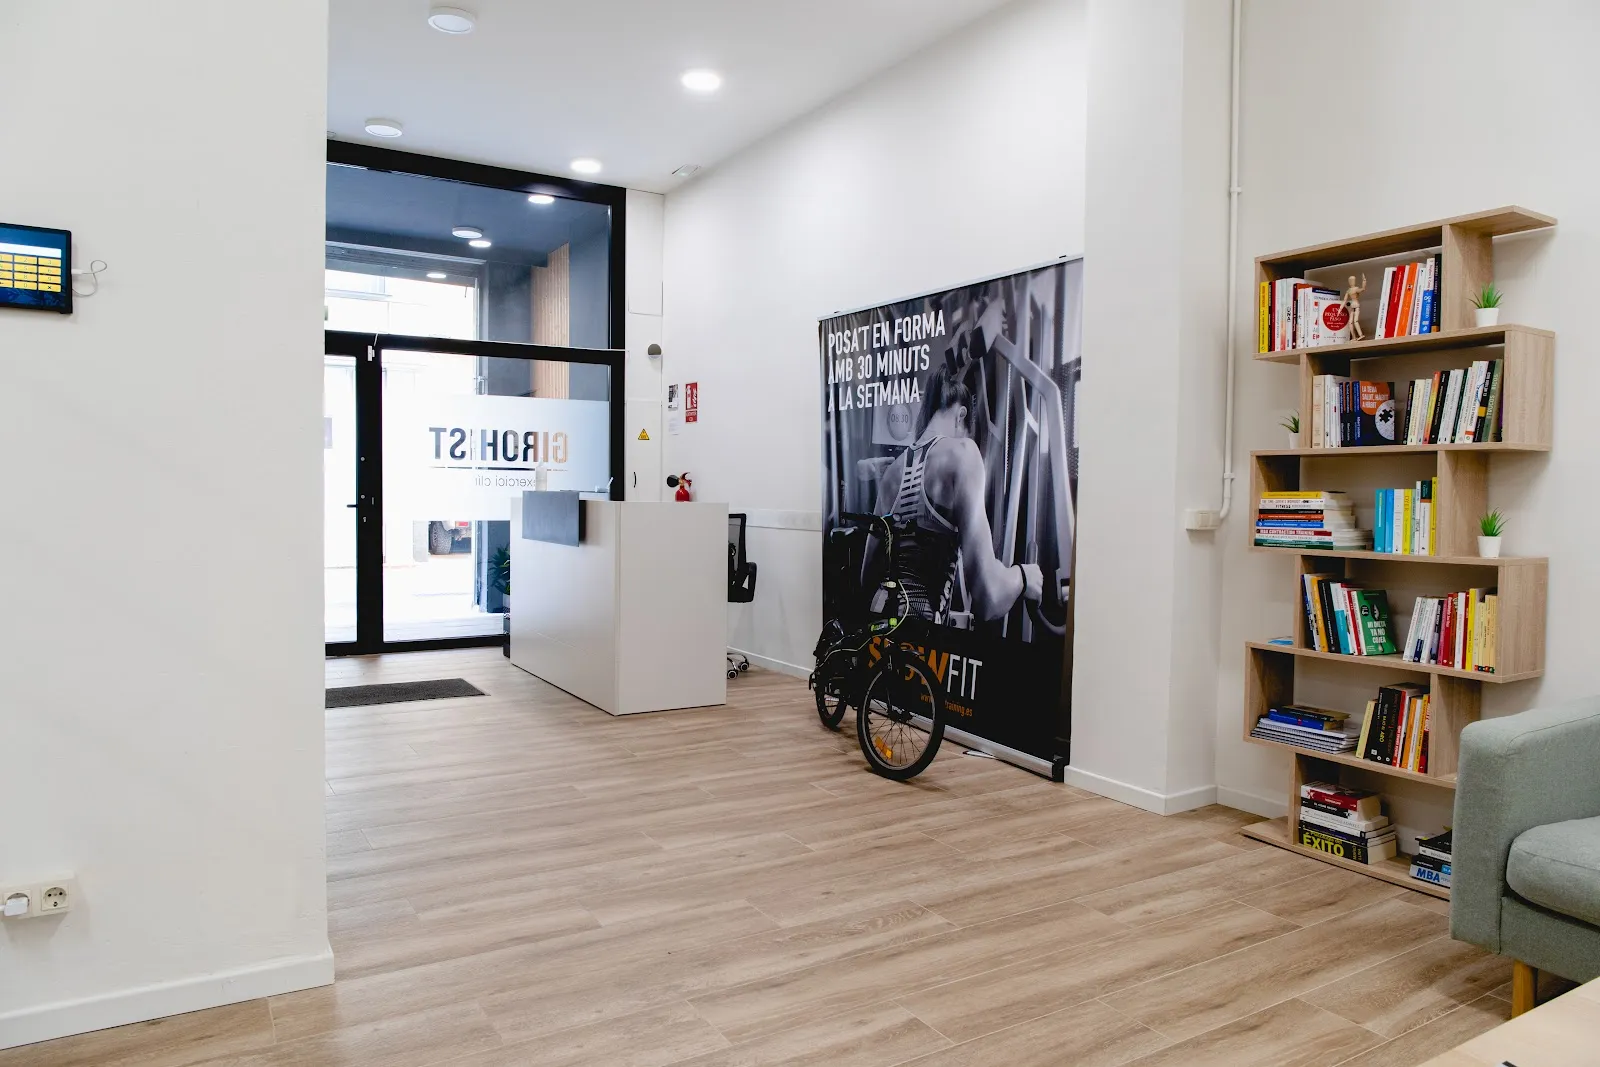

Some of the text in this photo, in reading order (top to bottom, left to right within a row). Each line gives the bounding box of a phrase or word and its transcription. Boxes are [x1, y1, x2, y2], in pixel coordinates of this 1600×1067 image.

[828, 309, 946, 357] POSA'T EN FORMA
[828, 344, 930, 385] AMB 30 MINUTS
[828, 376, 921, 413] A LA SETMANA
[1303, 832, 1345, 857] ÉXITO
[1416, 867, 1440, 883] MBA
